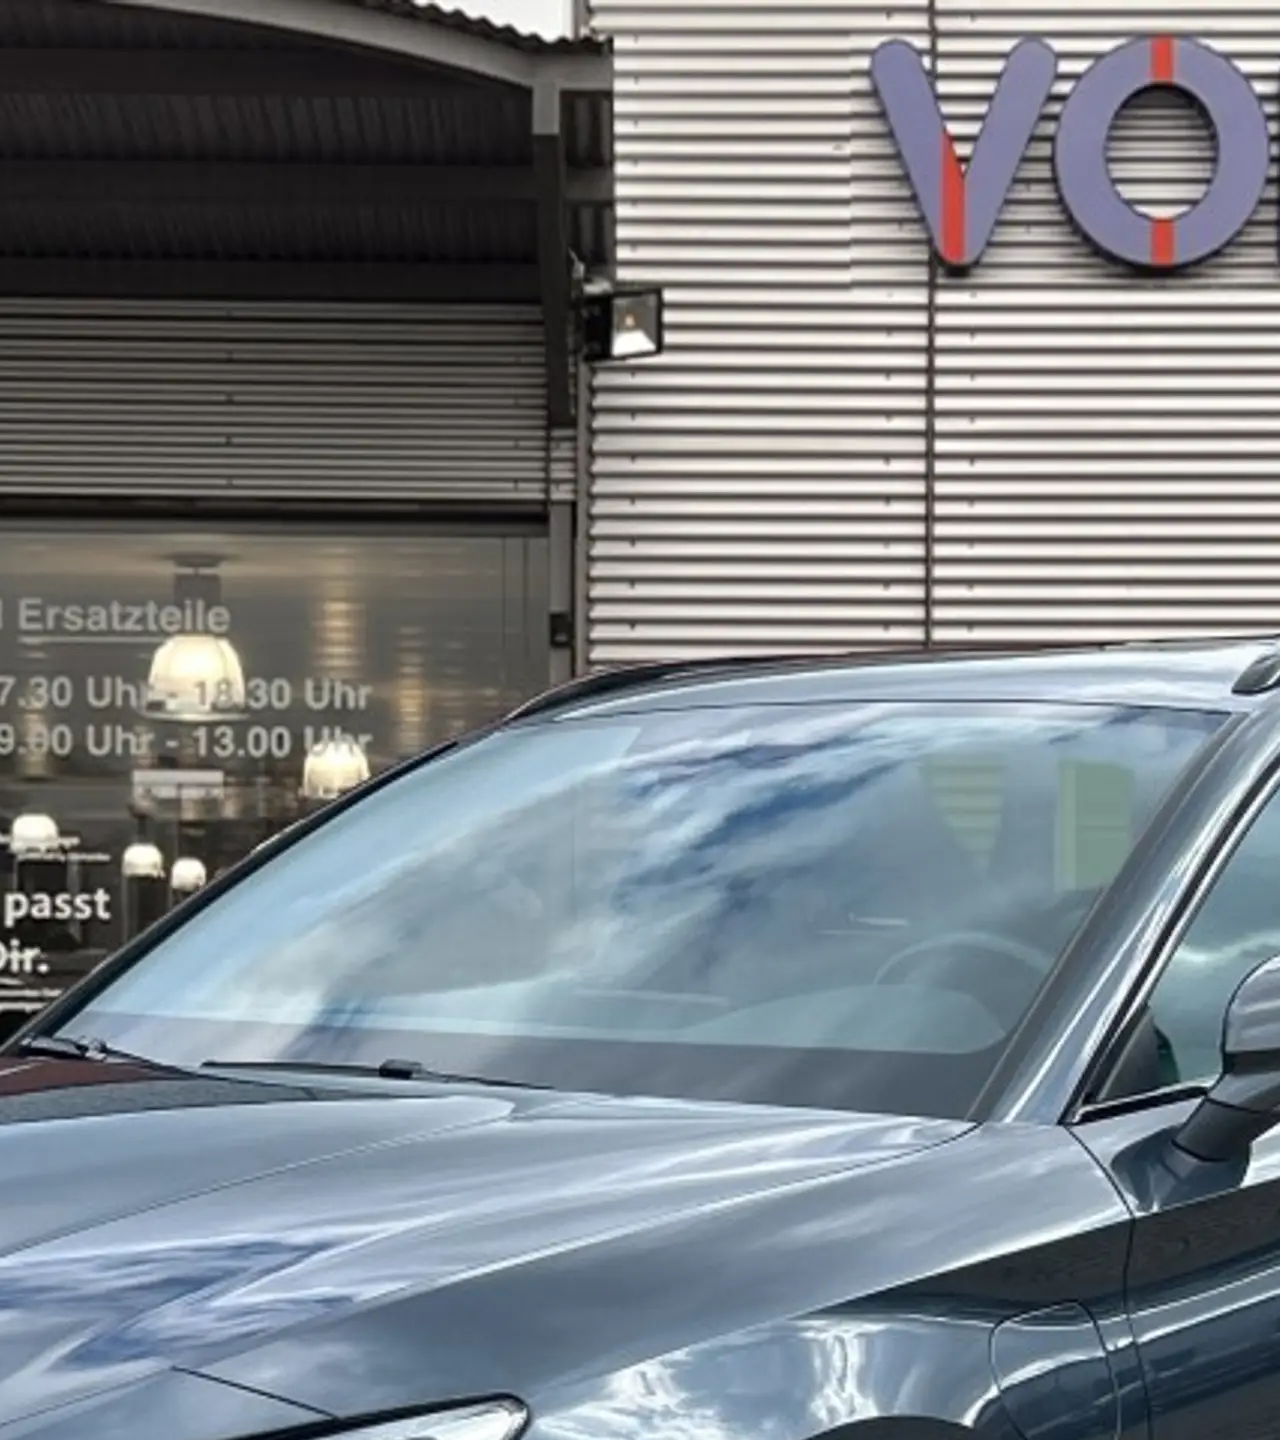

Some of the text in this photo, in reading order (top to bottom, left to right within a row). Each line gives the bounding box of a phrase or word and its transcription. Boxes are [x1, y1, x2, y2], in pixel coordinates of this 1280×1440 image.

[19, 597, 231, 634] Ersatzteile
[87, 676, 156, 709] Uhr
[193, 677, 291, 710] 1830
[304, 680, 373, 711] Uhr
[86, 724, 155, 757] Uhr
[193, 726, 291, 758] 13.00
[4, 888, 111, 929] passt
